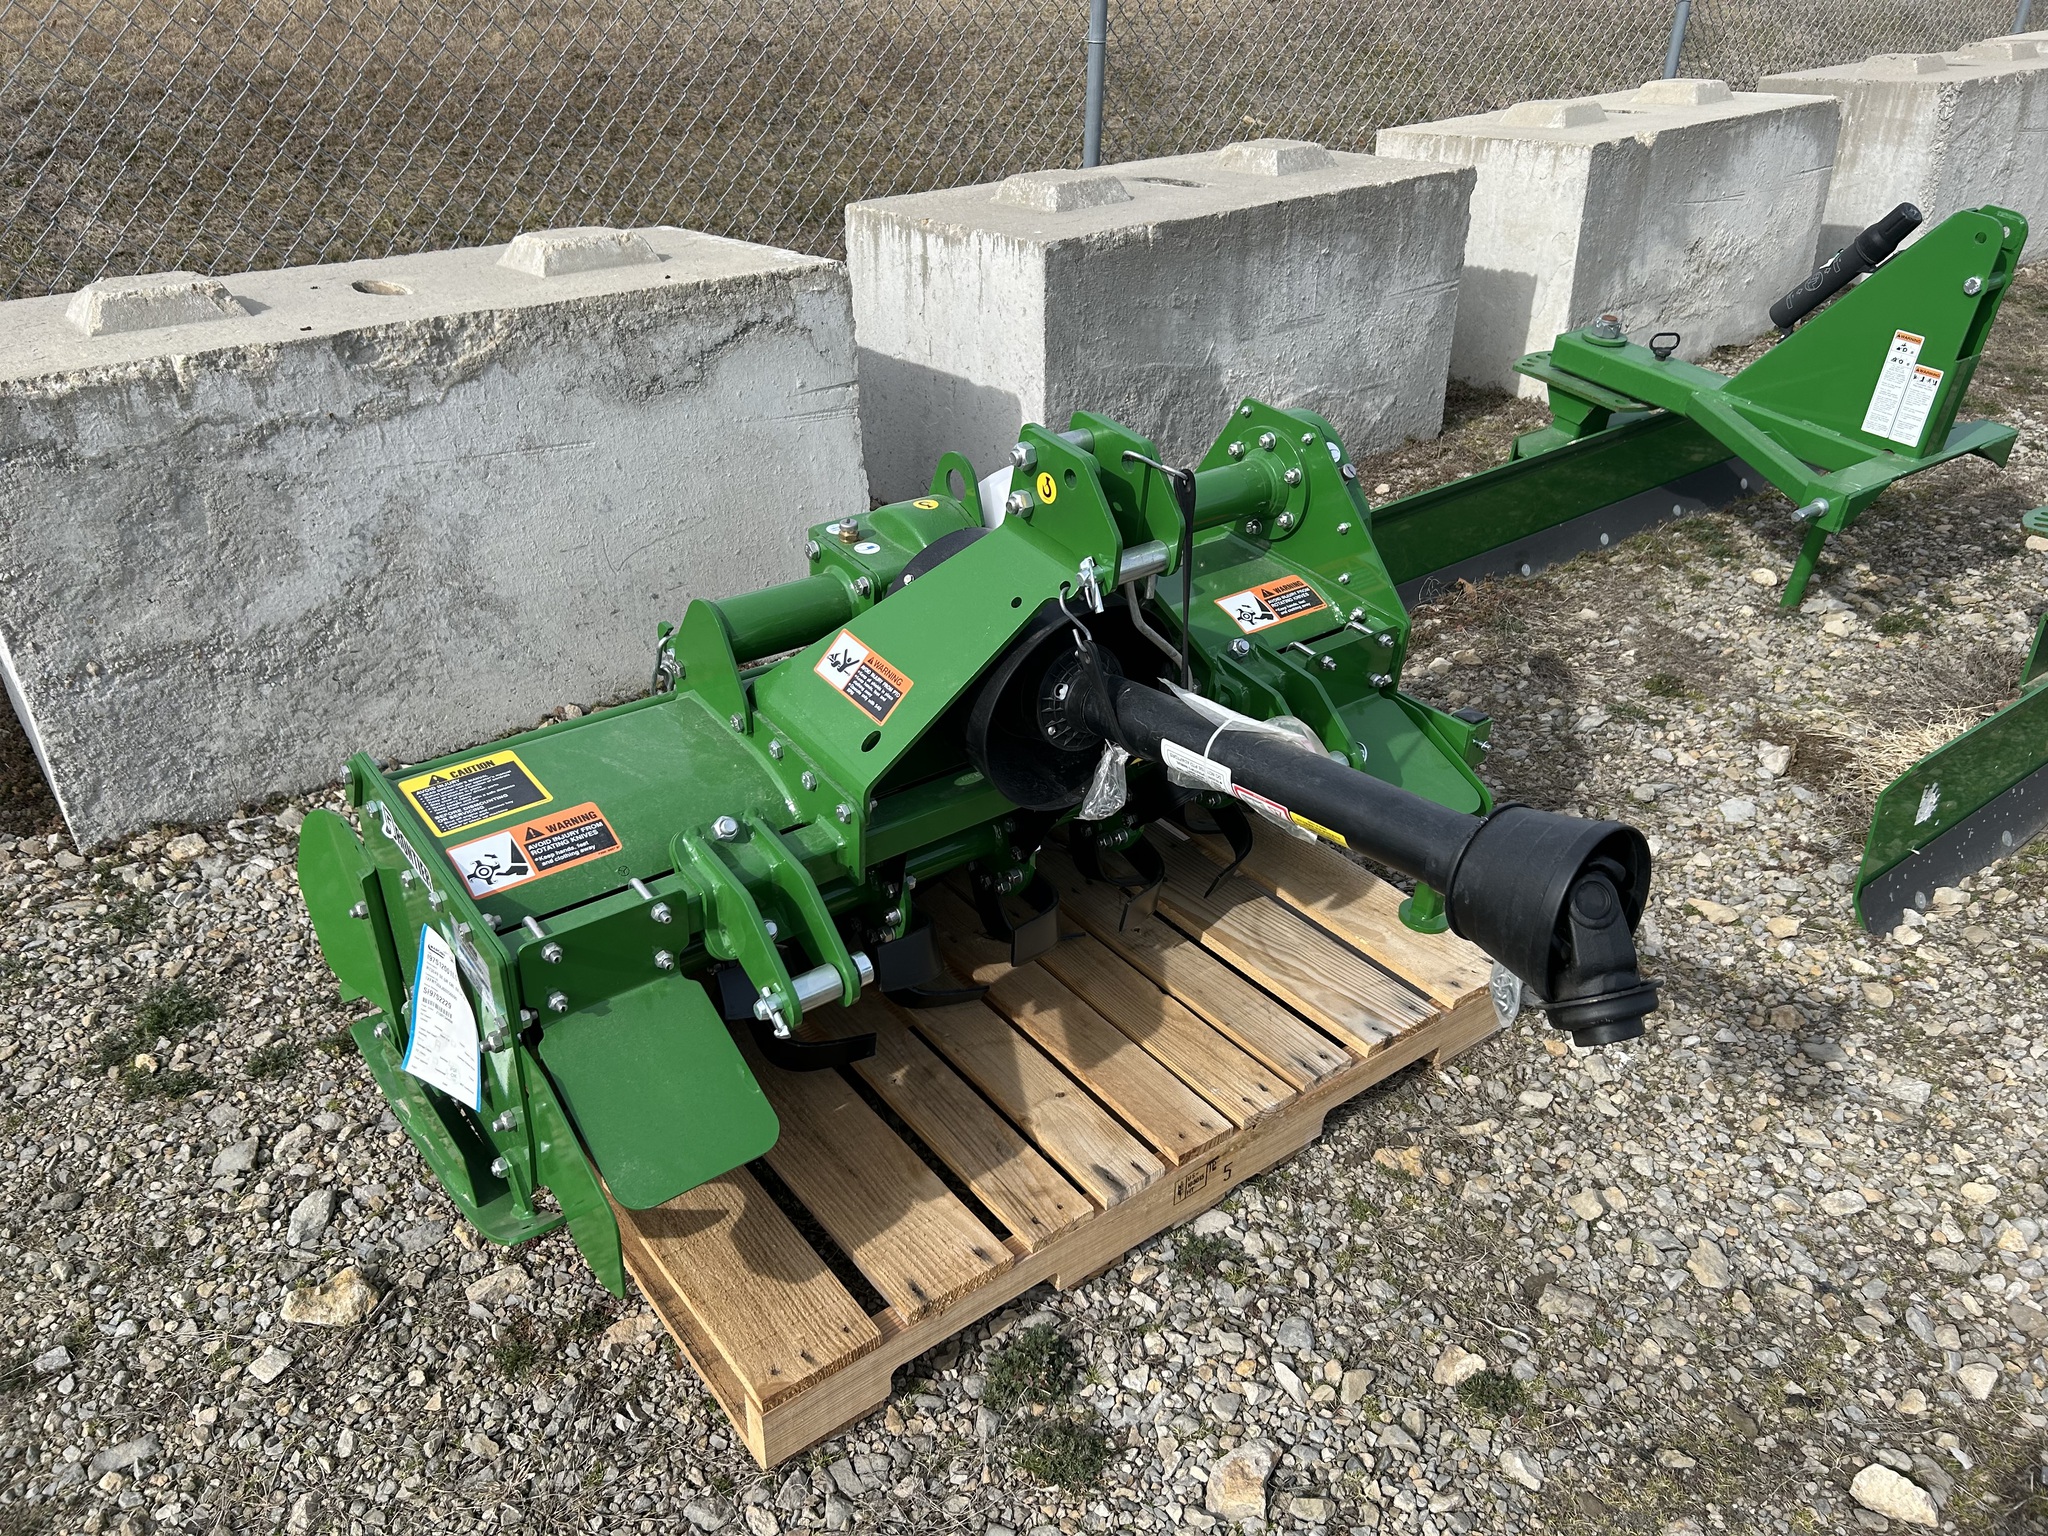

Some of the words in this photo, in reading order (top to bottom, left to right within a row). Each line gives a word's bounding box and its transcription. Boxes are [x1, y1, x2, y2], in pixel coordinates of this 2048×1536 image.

[1901, 335, 1921, 343] WARNING
[1920, 369, 1940, 377] WARNING
[1273, 580, 1304, 594] WARNING
[1271, 598, 1293, 607] ROTATING
[861, 665, 871, 674] AVOID
[870, 672, 883, 683] INJURY
[882, 682, 893, 691] FROM
[892, 689, 900, 697] PTO
[874, 660, 904, 686] WARNING
[1170, 753, 1189, 764] ADAPTORS
[450, 760, 496, 778] CAUTION
[416, 786, 436, 795] AVOID
[437, 779, 459, 788] INJURY
[434, 809, 461, 819] BEFORE
[463, 794, 508, 810] DISMOUNTING
[449, 806, 484, 819] SERVICING
[545, 810, 598, 833] WARNING
[528, 839, 551, 850] AVOID
[552, 829, 579, 841] INJURY
[580, 822, 603, 832] FROM
[530, 839, 569, 855] ROTATING
[570, 829, 598, 842] KNIVES
[554, 850, 579, 861] clothing
[580, 845, 595, 853] away
[1223, 1161, 1233, 1182] 5
